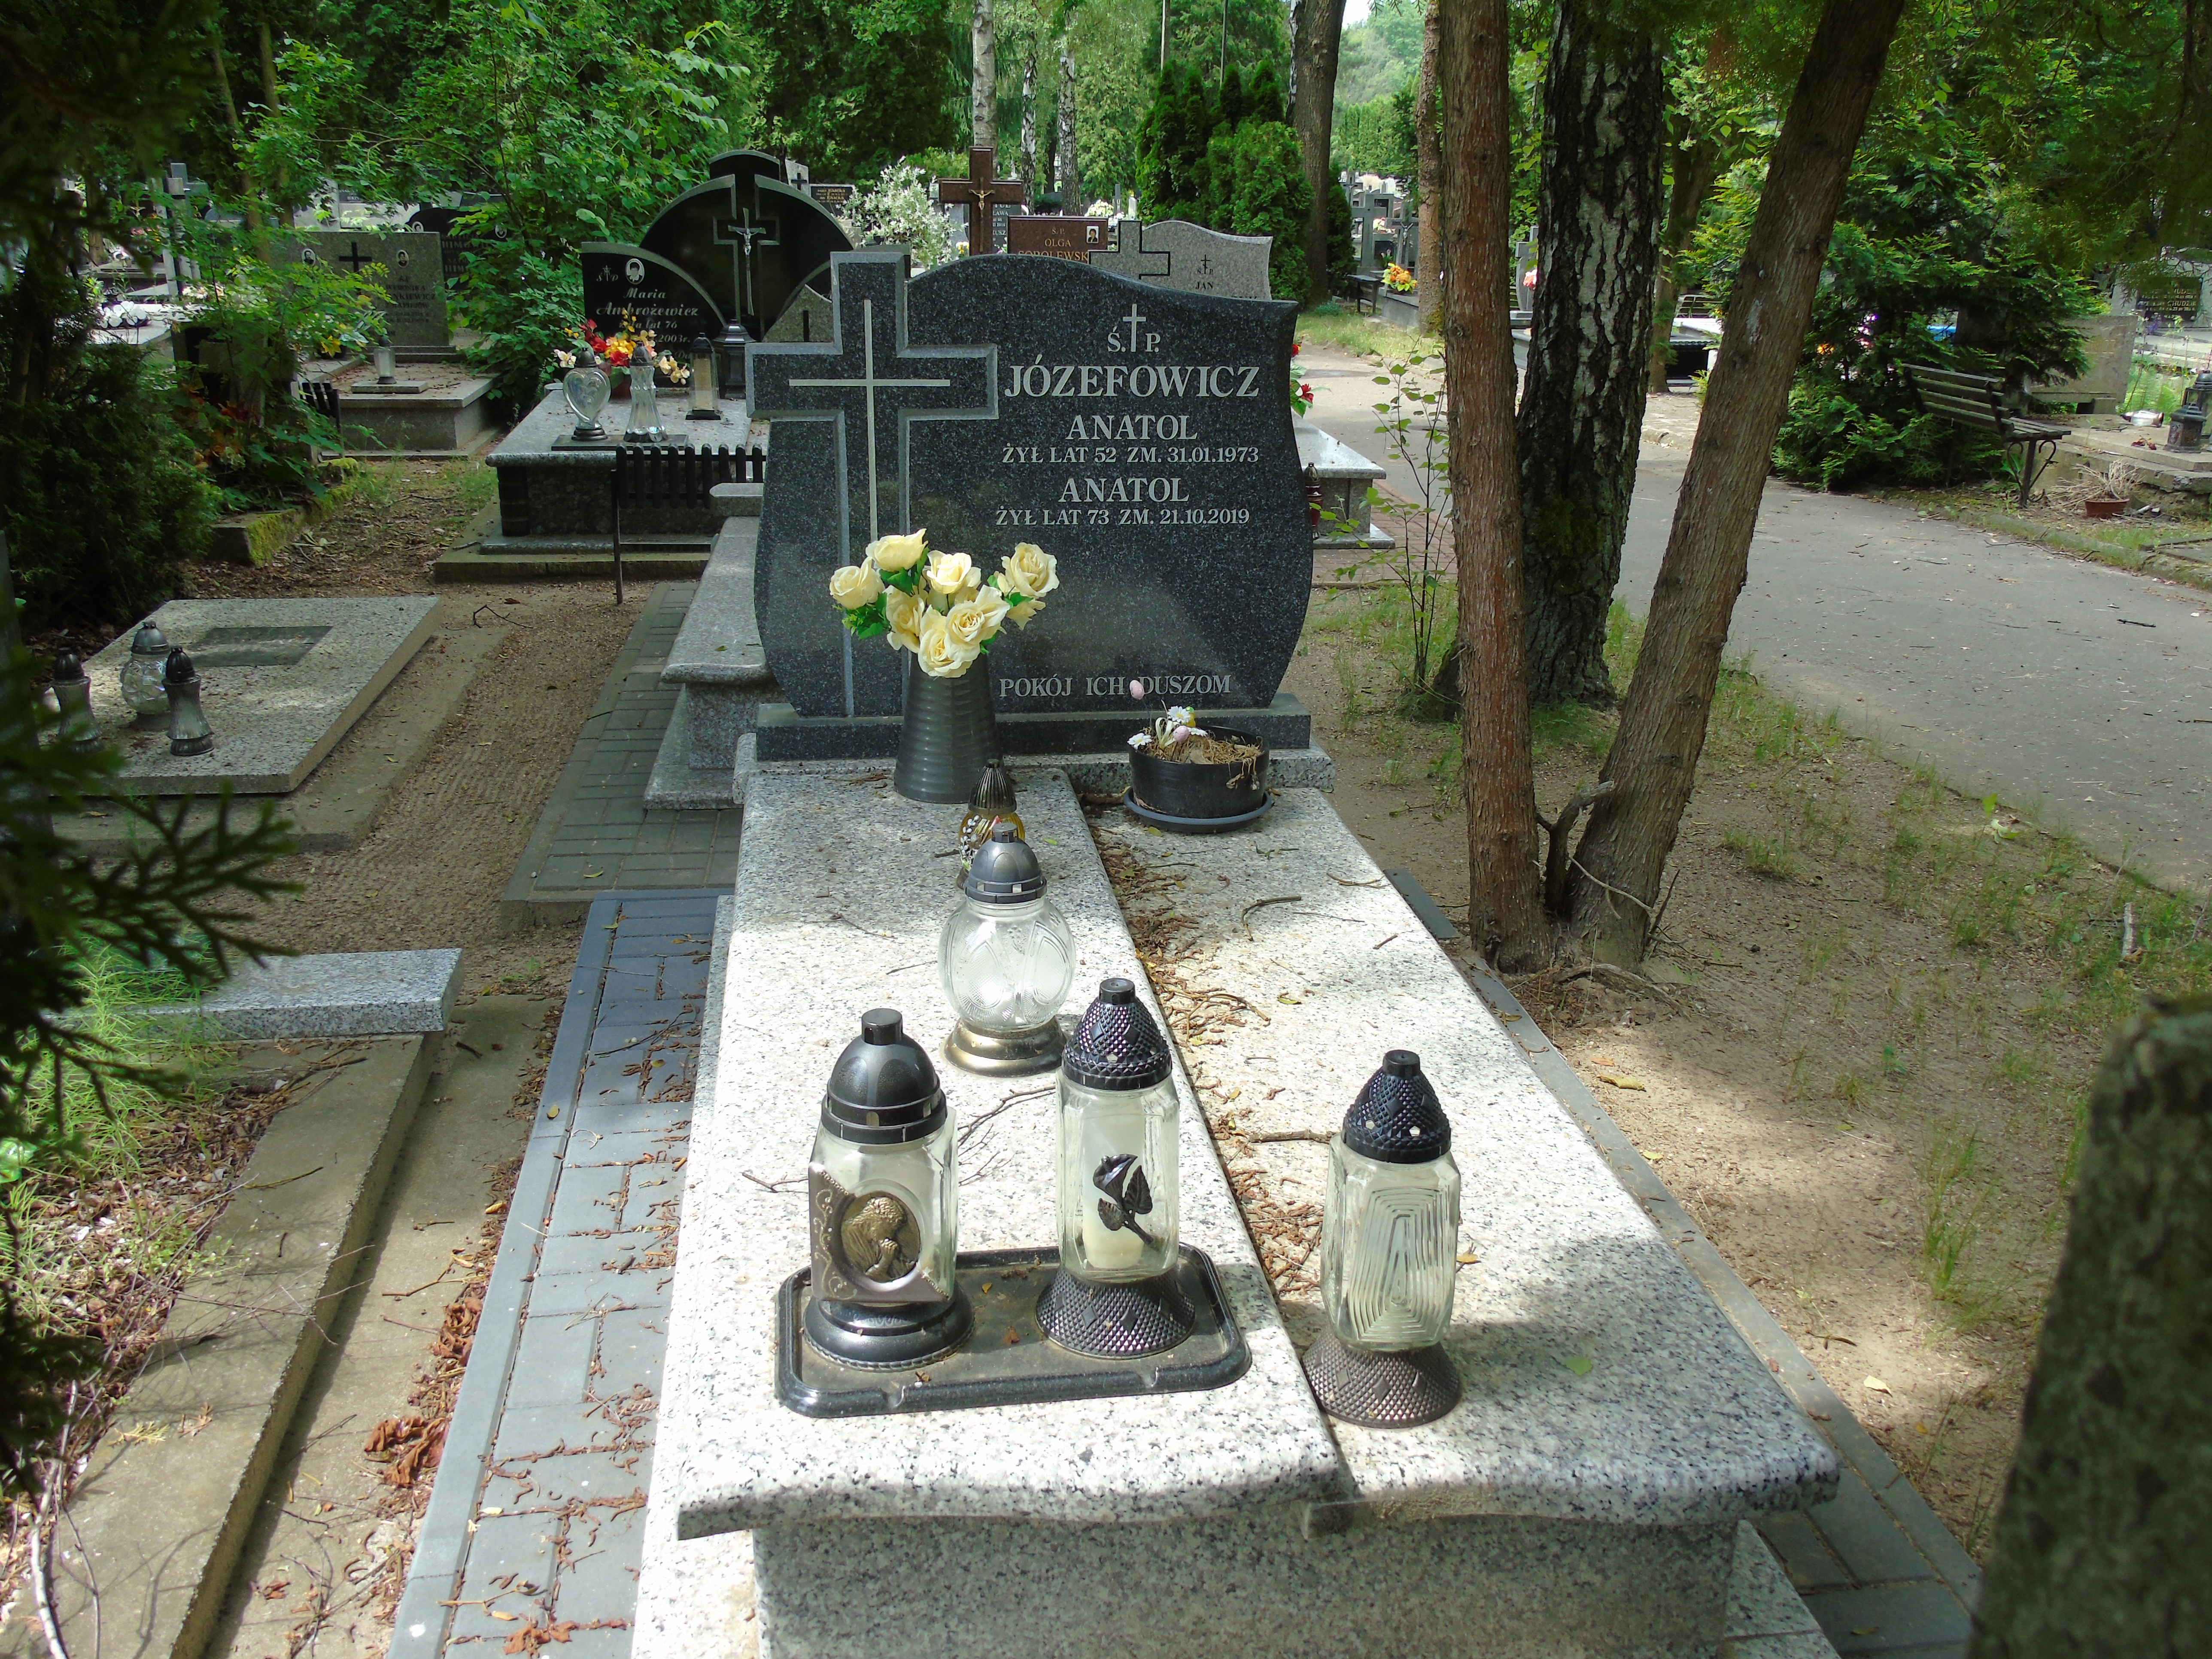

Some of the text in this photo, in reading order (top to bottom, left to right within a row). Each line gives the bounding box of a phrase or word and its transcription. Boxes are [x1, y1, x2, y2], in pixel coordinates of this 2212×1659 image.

[1045, 238, 1072, 247] OLGA
[623, 287, 667, 299] Maria
[1195, 282, 1214, 290] JAN
[596, 302, 699, 316] Ambrożewicz
[1004, 354, 1260, 397] JÓZEFOWICZ
[1065, 415, 1198, 440] ANATOL
[1002, 443, 1259, 463] ŻYŁ LAT 52 ZM. 31.01.1973
[1058, 477, 1189, 502] ANATOL
[996, 506, 1250, 526] ŻYŁ LAT 73 ZM. 21.10.2019
[999, 673, 1232, 697] POKÓJ ICH DUSZOM
